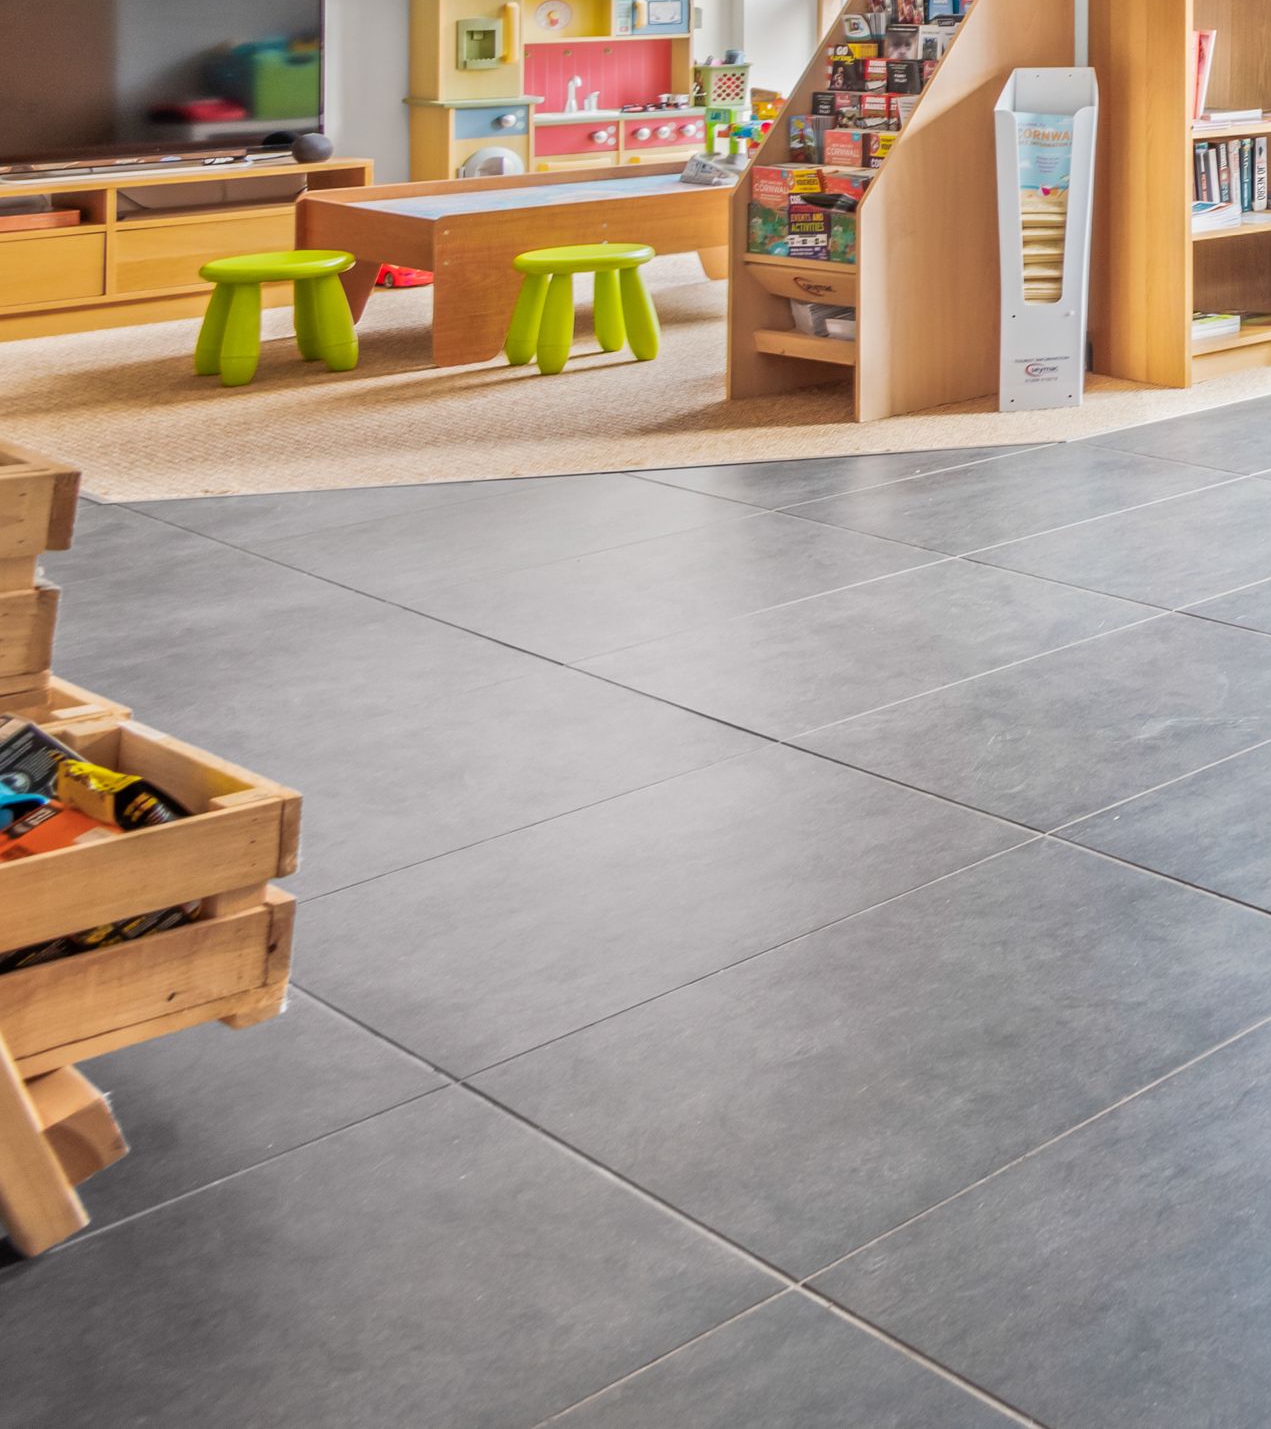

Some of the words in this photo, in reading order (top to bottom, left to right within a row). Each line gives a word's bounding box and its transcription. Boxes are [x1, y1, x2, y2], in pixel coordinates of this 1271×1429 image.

[1018, 128, 1071, 141] CORNWA
[812, 212, 824, 221] AND
[791, 222, 824, 233] ACTIVITIES
